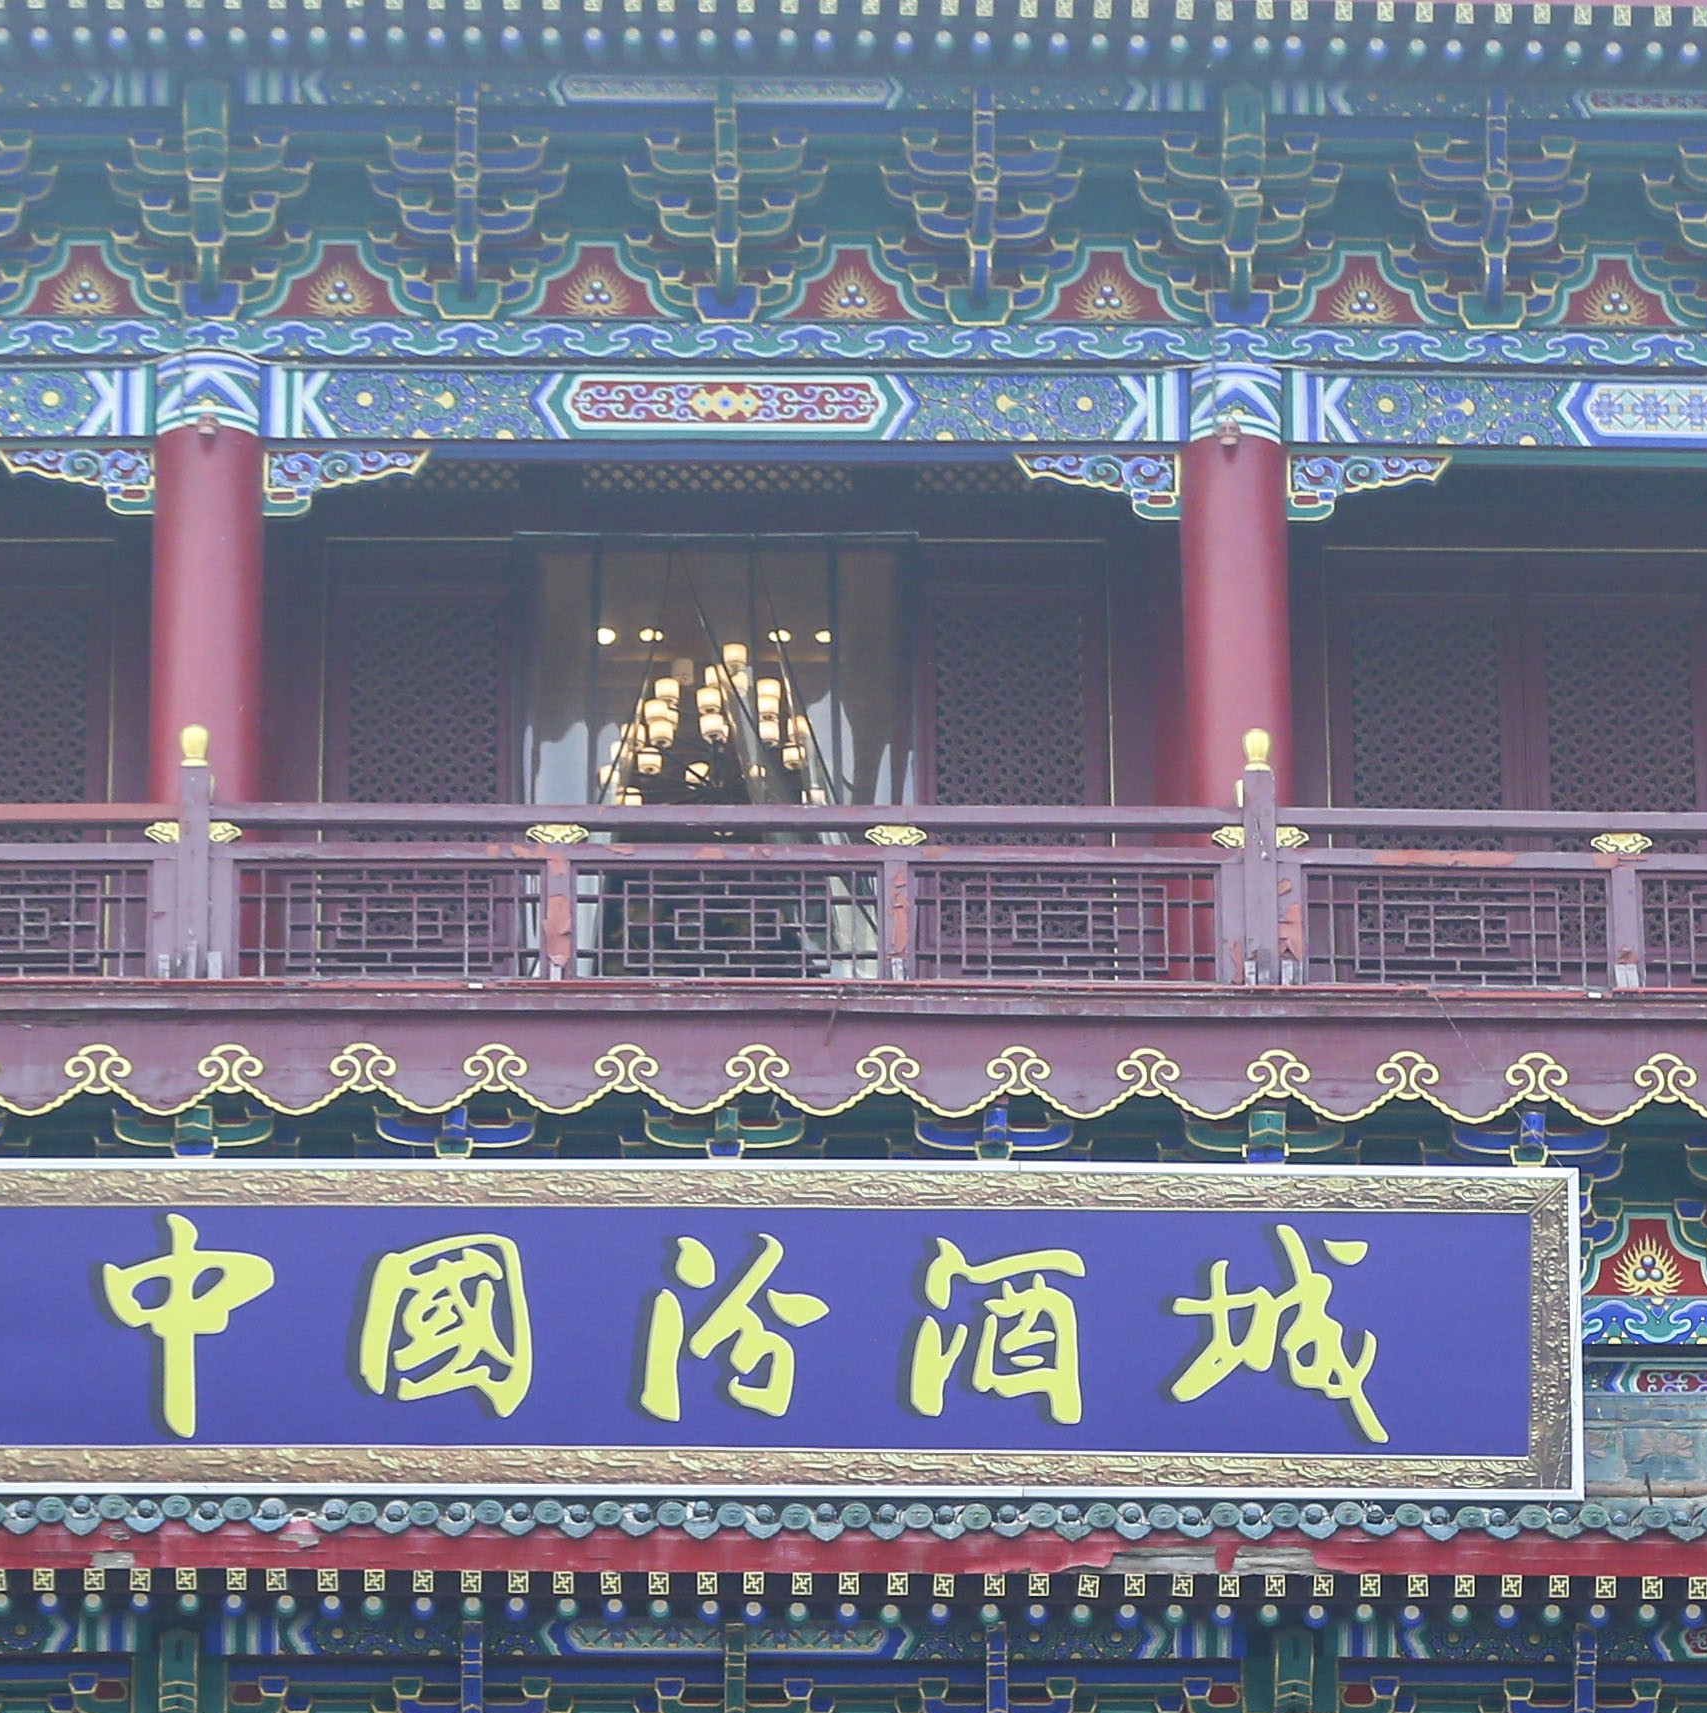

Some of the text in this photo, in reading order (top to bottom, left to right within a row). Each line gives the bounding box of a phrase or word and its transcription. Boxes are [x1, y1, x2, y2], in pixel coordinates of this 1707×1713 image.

[102, 1216, 1386, 1443] 中國汾酒城
